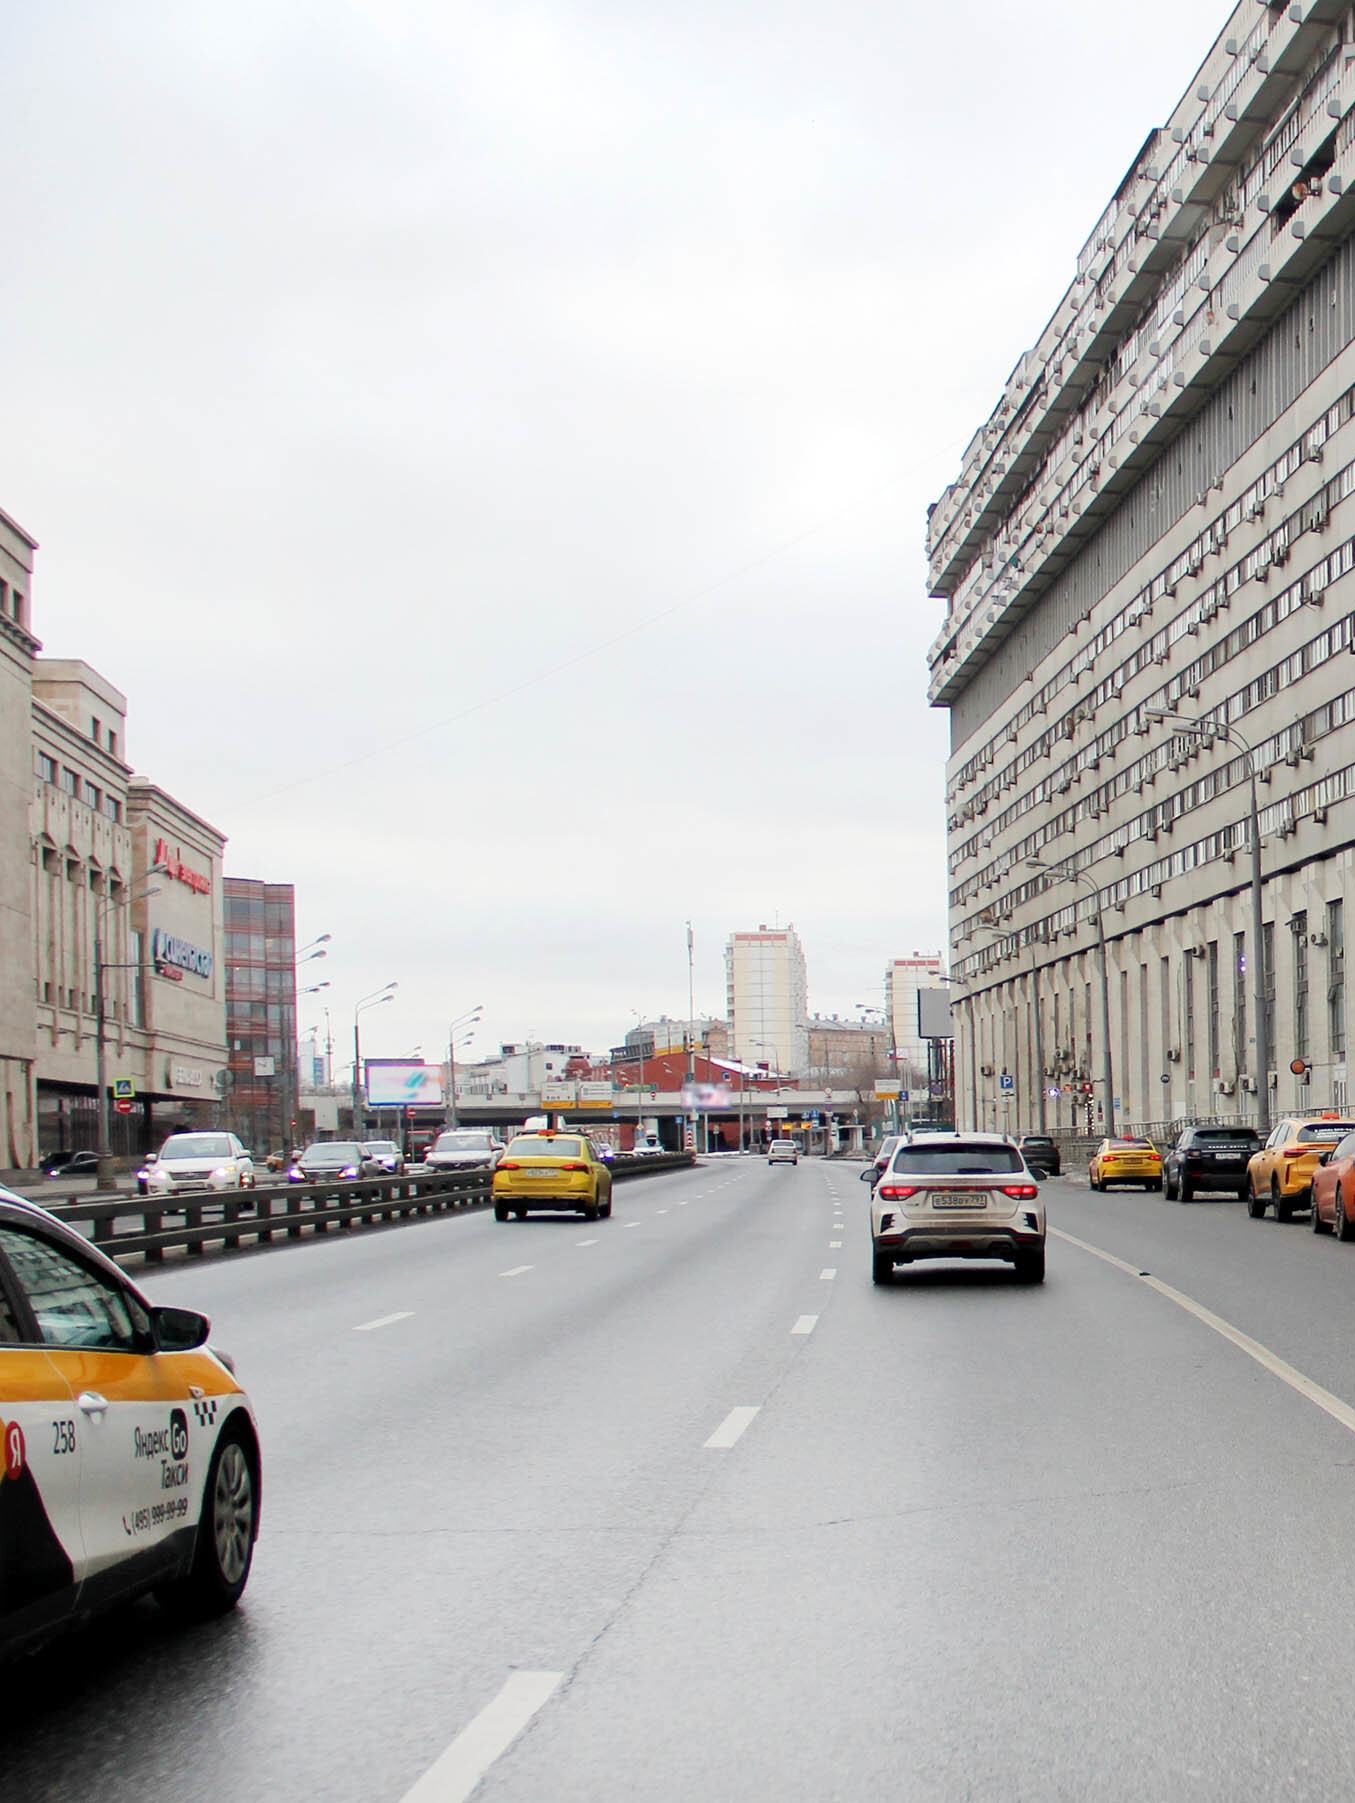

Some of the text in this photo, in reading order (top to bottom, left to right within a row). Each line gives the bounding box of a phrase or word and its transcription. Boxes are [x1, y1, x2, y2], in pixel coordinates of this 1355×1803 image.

[10, 1427, 22, 1469] Я
[52, 1420, 76, 1455] 258
[134, 1421, 187, 1460] Яндекс Go
[160, 1459, 189, 1490] Такси
[131, 1507, 152, 1536] (495)
